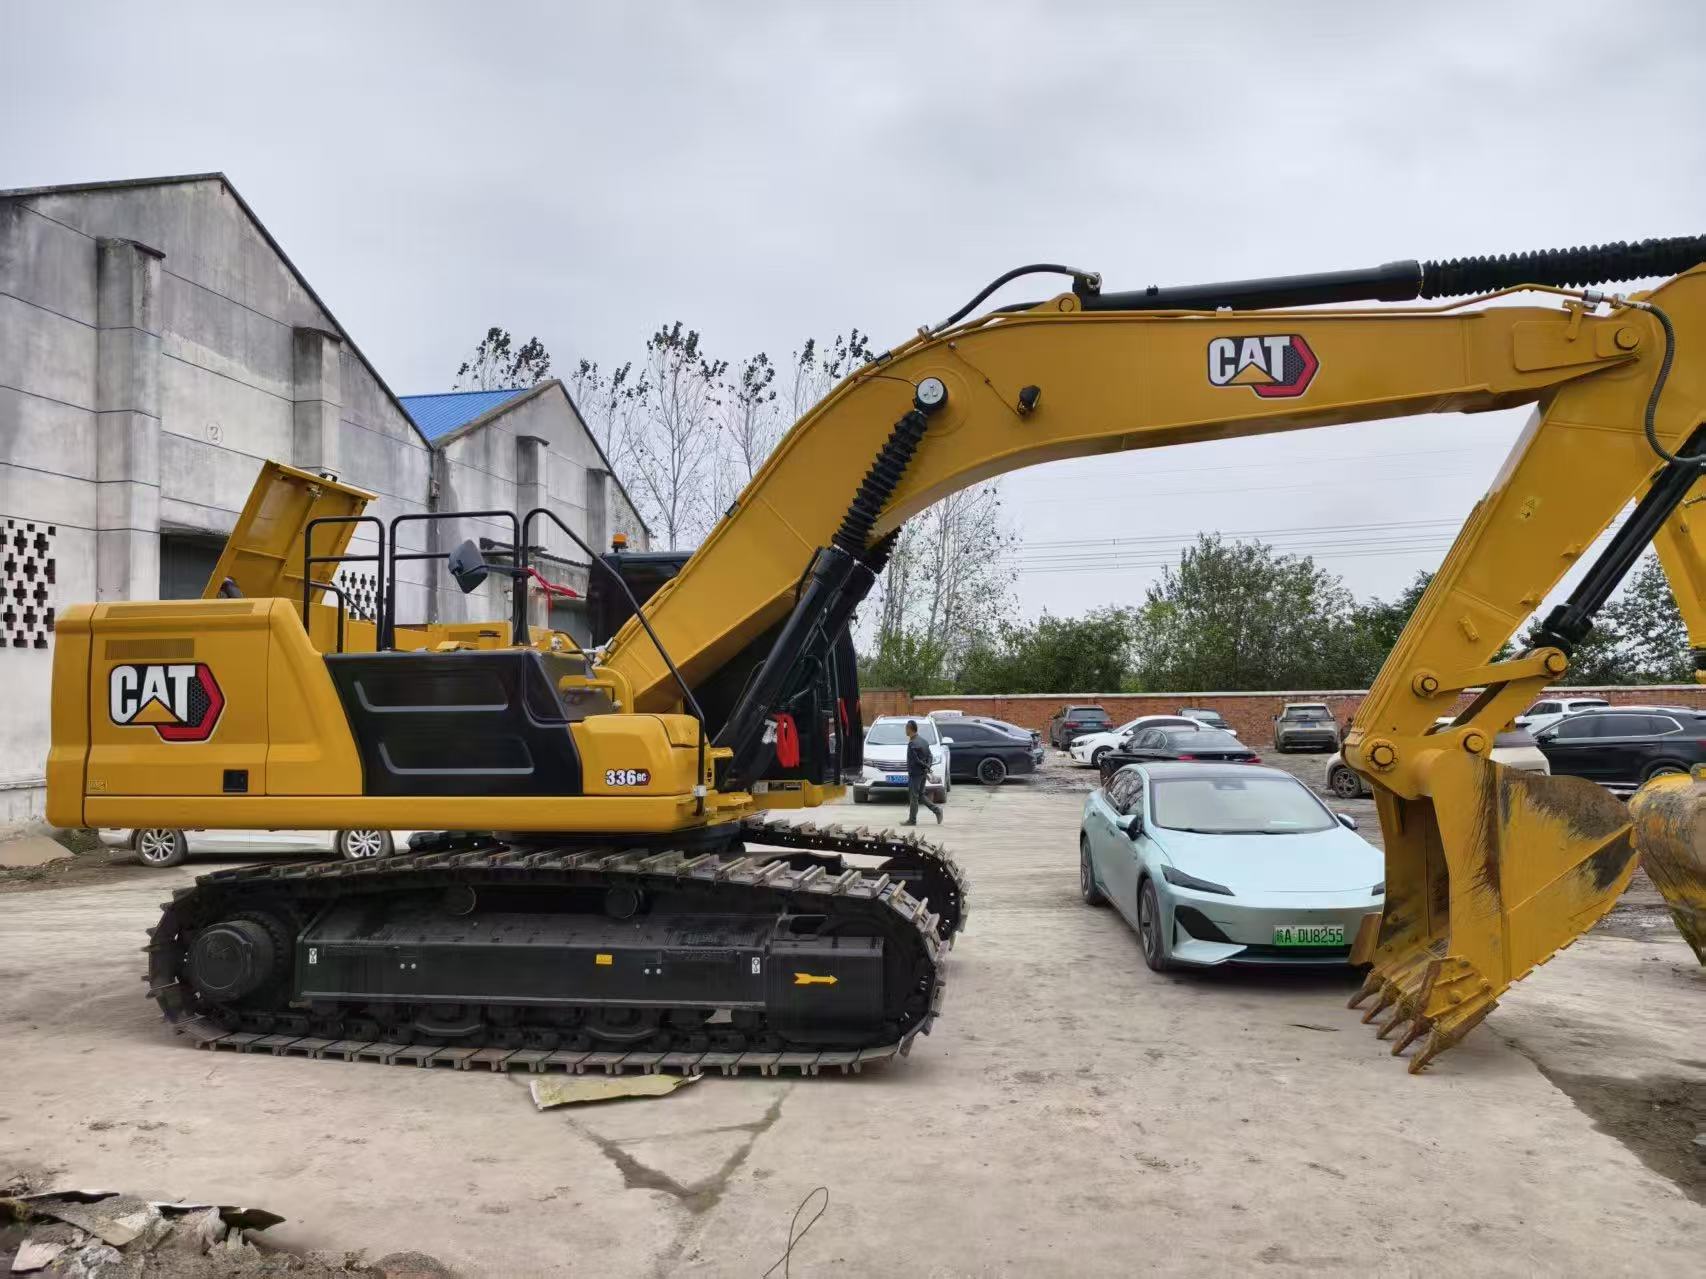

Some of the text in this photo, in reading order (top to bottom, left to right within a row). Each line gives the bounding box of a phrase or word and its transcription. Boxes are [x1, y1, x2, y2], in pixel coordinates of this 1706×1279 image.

[1209, 335, 1290, 385] CAT
[110, 664, 196, 724] CAT
[606, 769, 636, 786] 336
[1297, 927, 1344, 943] DU8255
